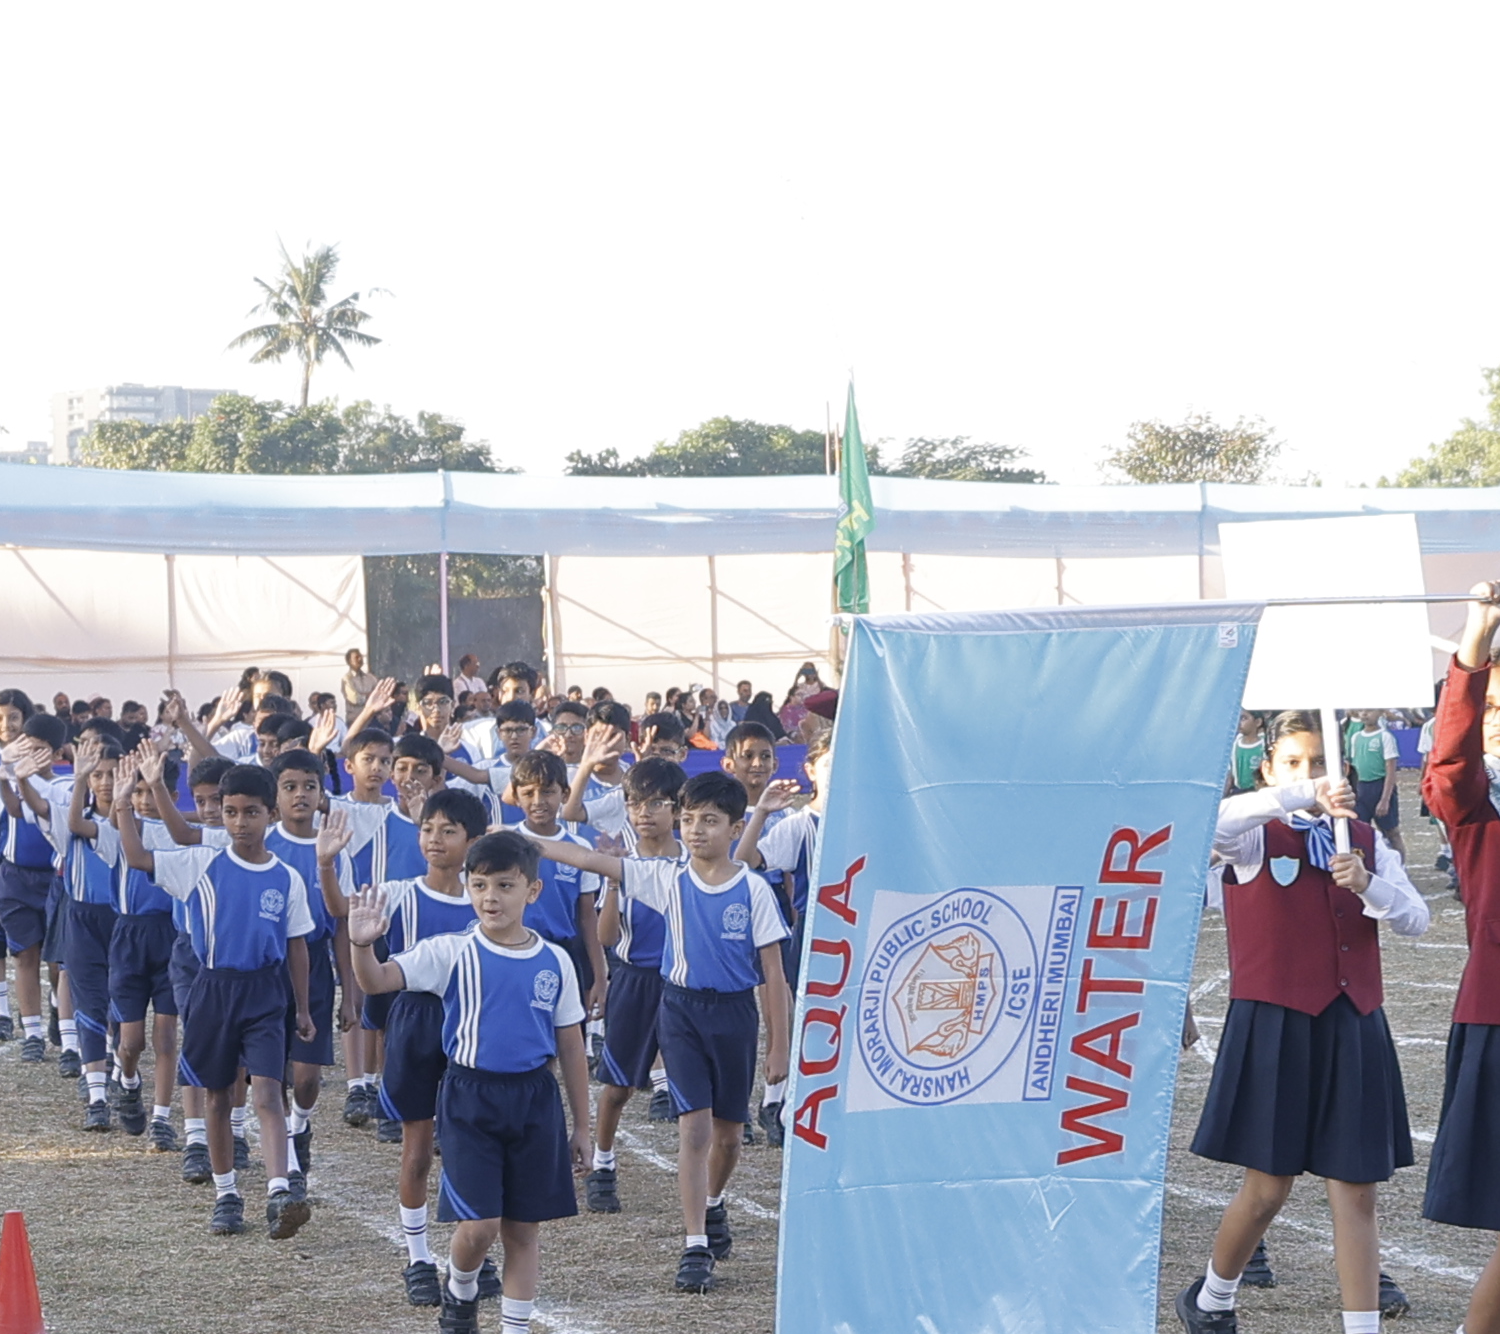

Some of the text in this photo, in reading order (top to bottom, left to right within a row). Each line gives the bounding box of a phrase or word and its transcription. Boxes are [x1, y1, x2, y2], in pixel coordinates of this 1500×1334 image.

[793, 854, 868, 1151] AQUA
[862, 897, 994, 1099] HANSRAJ MORARJI PUBLIC SCHOOL
[972, 966, 990, 1021] HMPS
[1004, 966, 1031, 1021] ICSE
[1032, 894, 1078, 1092] ANDHERI MUMBAI
[1056, 822, 1174, 1167] WATER
